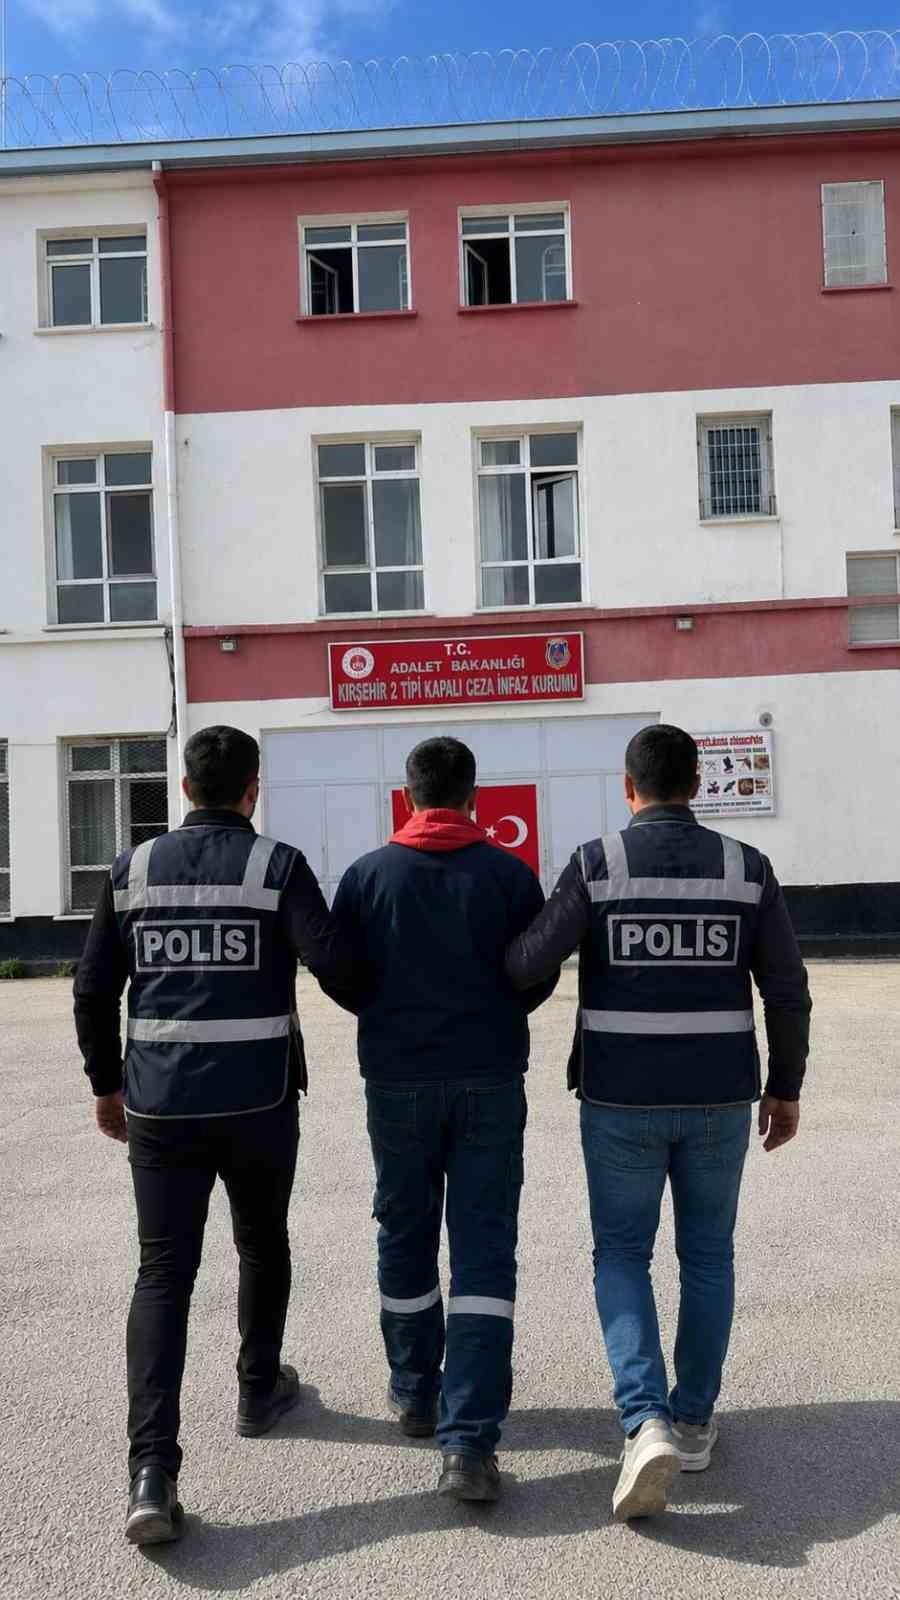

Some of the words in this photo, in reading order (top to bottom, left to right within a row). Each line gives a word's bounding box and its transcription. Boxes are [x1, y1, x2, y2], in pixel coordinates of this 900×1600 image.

[390, 660, 442, 673] ADALET
[451, 654, 525, 672] BAKANLIĞI
[443, 643, 471, 656] T.C.
[338, 678, 386, 706] KIRŞEHİR
[390, 683, 398, 699] 2
[400, 676, 421, 698] TİPİ
[424, 679, 461, 698] KAPALI
[466, 678, 494, 696] CEZA
[497, 672, 528, 695] İNFAZ
[532, 673, 577, 693] KURUMU
[143, 923, 247, 962] POLİS
[620, 919, 729, 957] POLİS
